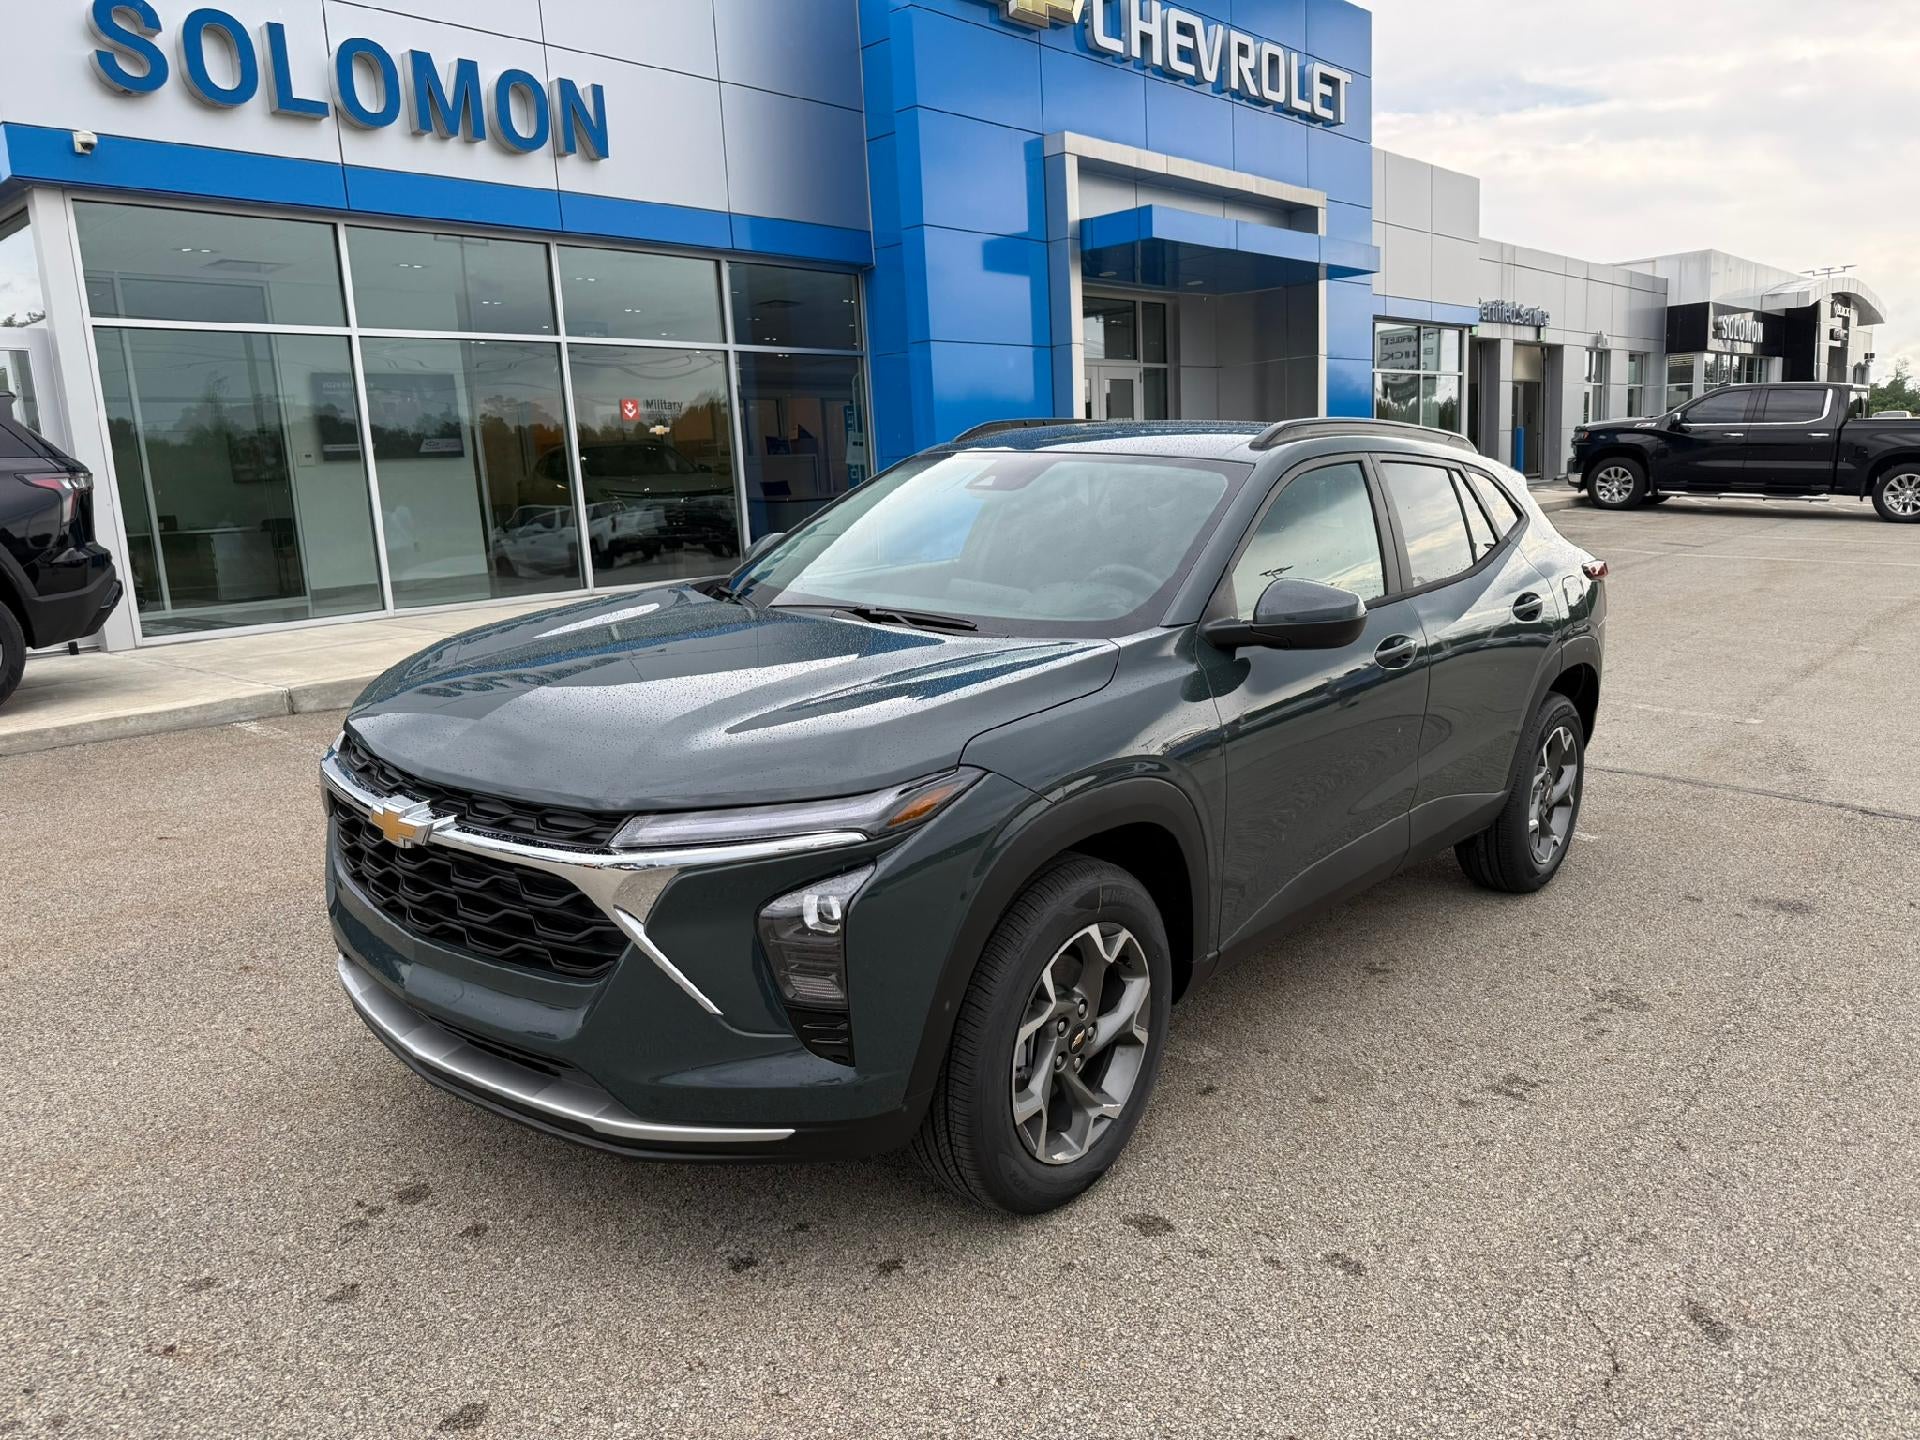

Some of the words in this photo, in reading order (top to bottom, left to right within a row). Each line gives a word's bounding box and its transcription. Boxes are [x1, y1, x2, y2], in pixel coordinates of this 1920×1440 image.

[1086, 0, 1352, 126] CHEVROLET
[89, 0, 609, 161] SOLOMON
[1479, 298, 1517, 324] ertified
[1519, 304, 1550, 327] Service
[1721, 315, 1764, 343] SOLOMON
[645, 399, 683, 412] Military
